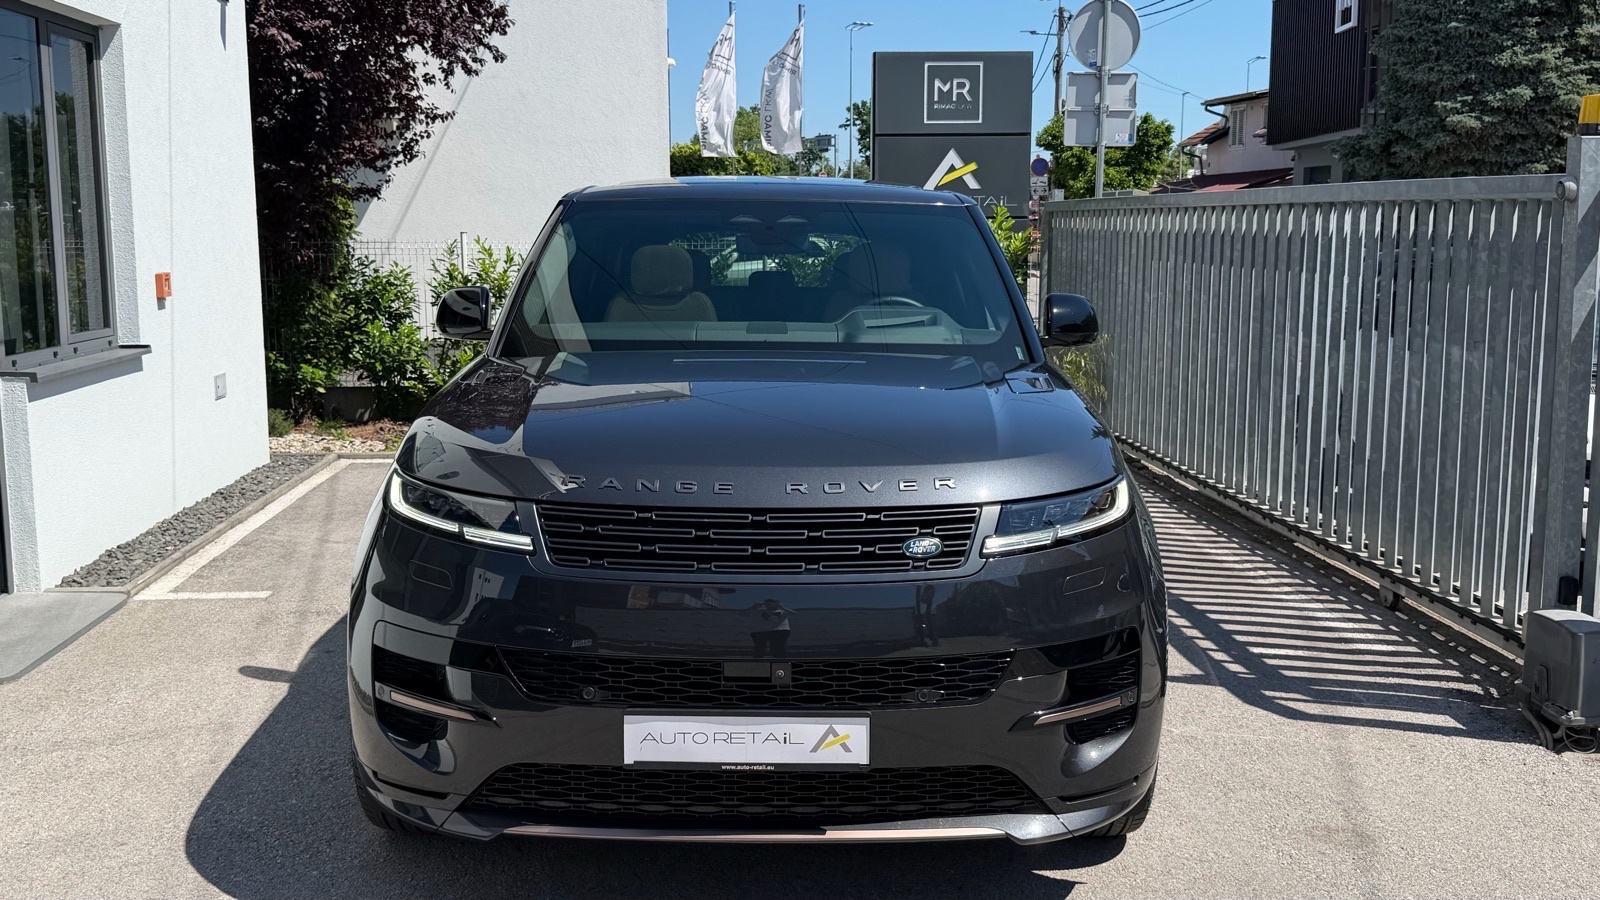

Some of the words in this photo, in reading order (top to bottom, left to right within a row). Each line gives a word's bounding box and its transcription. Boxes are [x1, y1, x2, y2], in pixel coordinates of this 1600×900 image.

[934, 78, 972, 101] MR
[561, 474, 734, 495] RANGE
[785, 476, 957, 495] ROVER
[910, 540, 930, 548] LAND
[912, 545, 936, 553] ROVER
